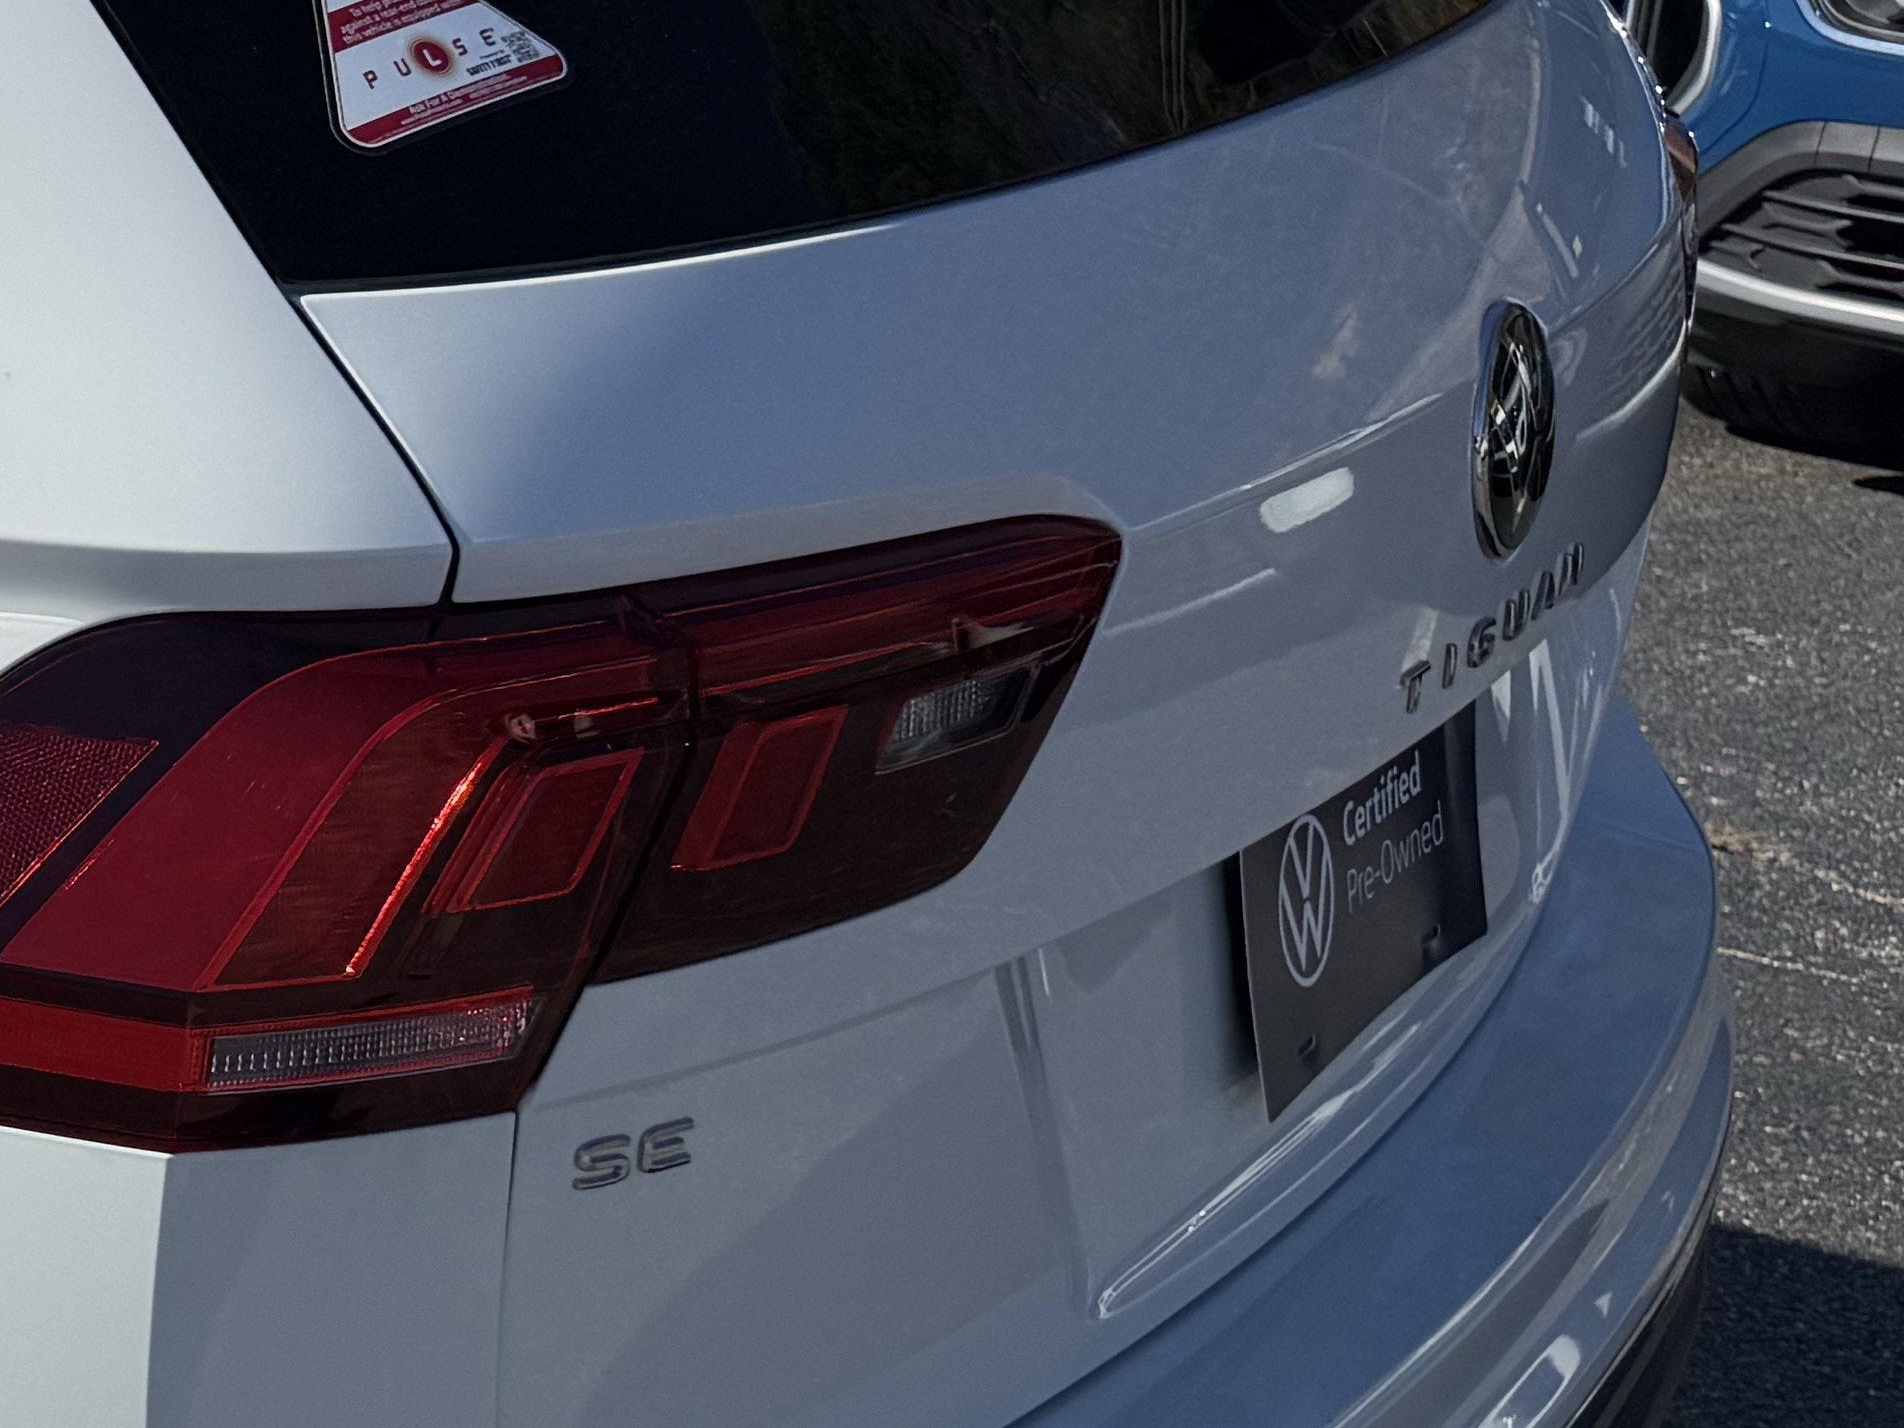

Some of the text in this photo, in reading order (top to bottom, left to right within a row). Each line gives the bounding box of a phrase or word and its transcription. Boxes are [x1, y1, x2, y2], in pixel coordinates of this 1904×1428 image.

[362, 28, 494, 89] PULSE
[1399, 541, 1584, 714] TIGUAN
[1343, 749, 1422, 846] Certified
[1347, 799, 1443, 913] Pre-Owned
[572, 1116, 694, 1190] SE
